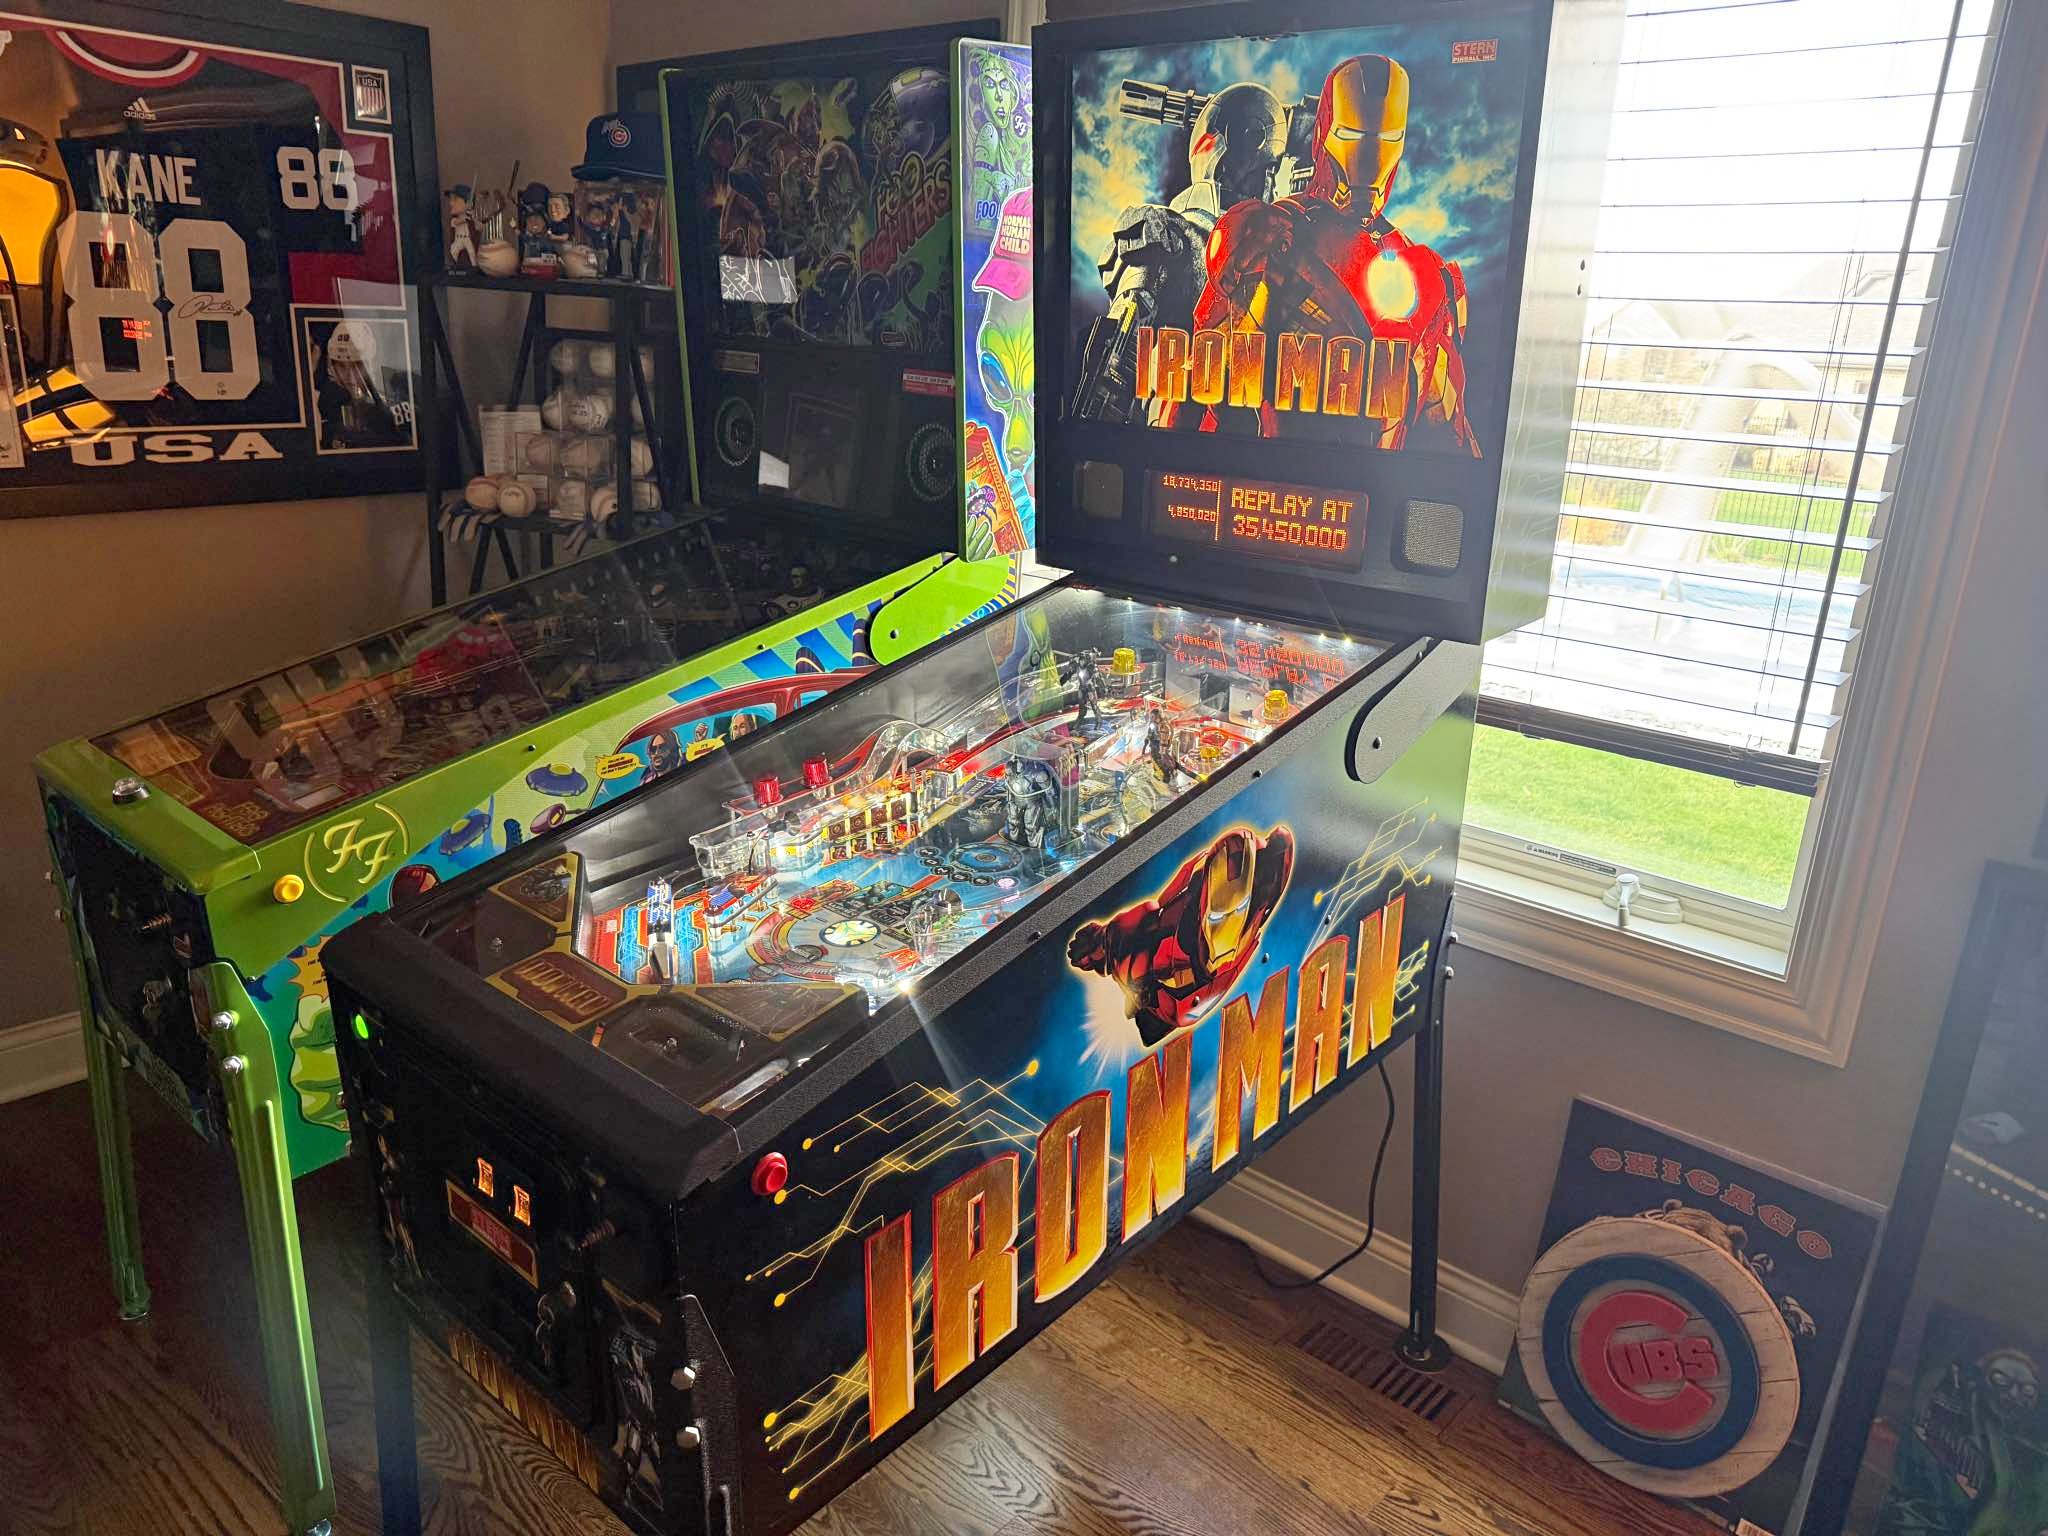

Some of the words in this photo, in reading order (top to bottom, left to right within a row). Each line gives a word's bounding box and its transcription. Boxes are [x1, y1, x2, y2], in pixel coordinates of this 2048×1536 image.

[1454, 41, 1496, 56] STERN
[362, 78, 378, 88] USA
[123, 110, 157, 120] adidas
[96, 148, 201, 206] KANE
[276, 146, 358, 211] 88
[1001, 225, 1031, 238] HUMAN
[1003, 215, 1032, 228] NORMAL
[1000, 235, 1030, 255] CHILD
[57, 210, 261, 401] 88
[1135, 326, 1266, 408] IRON
[1274, 331, 1412, 421] MAN
[72, 431, 284, 467] USA
[1231, 487, 1313, 518] REPLAY
[1322, 499, 1354, 523] AT
[1233, 514, 1347, 550] 35,450,000
[865, 1032, 1193, 1442] IRON
[1212, 893, 1406, 1174] MAN
[1590, 1147, 1833, 1260] CHICAGO
[1579, 1290, 1720, 1431] CUBS
